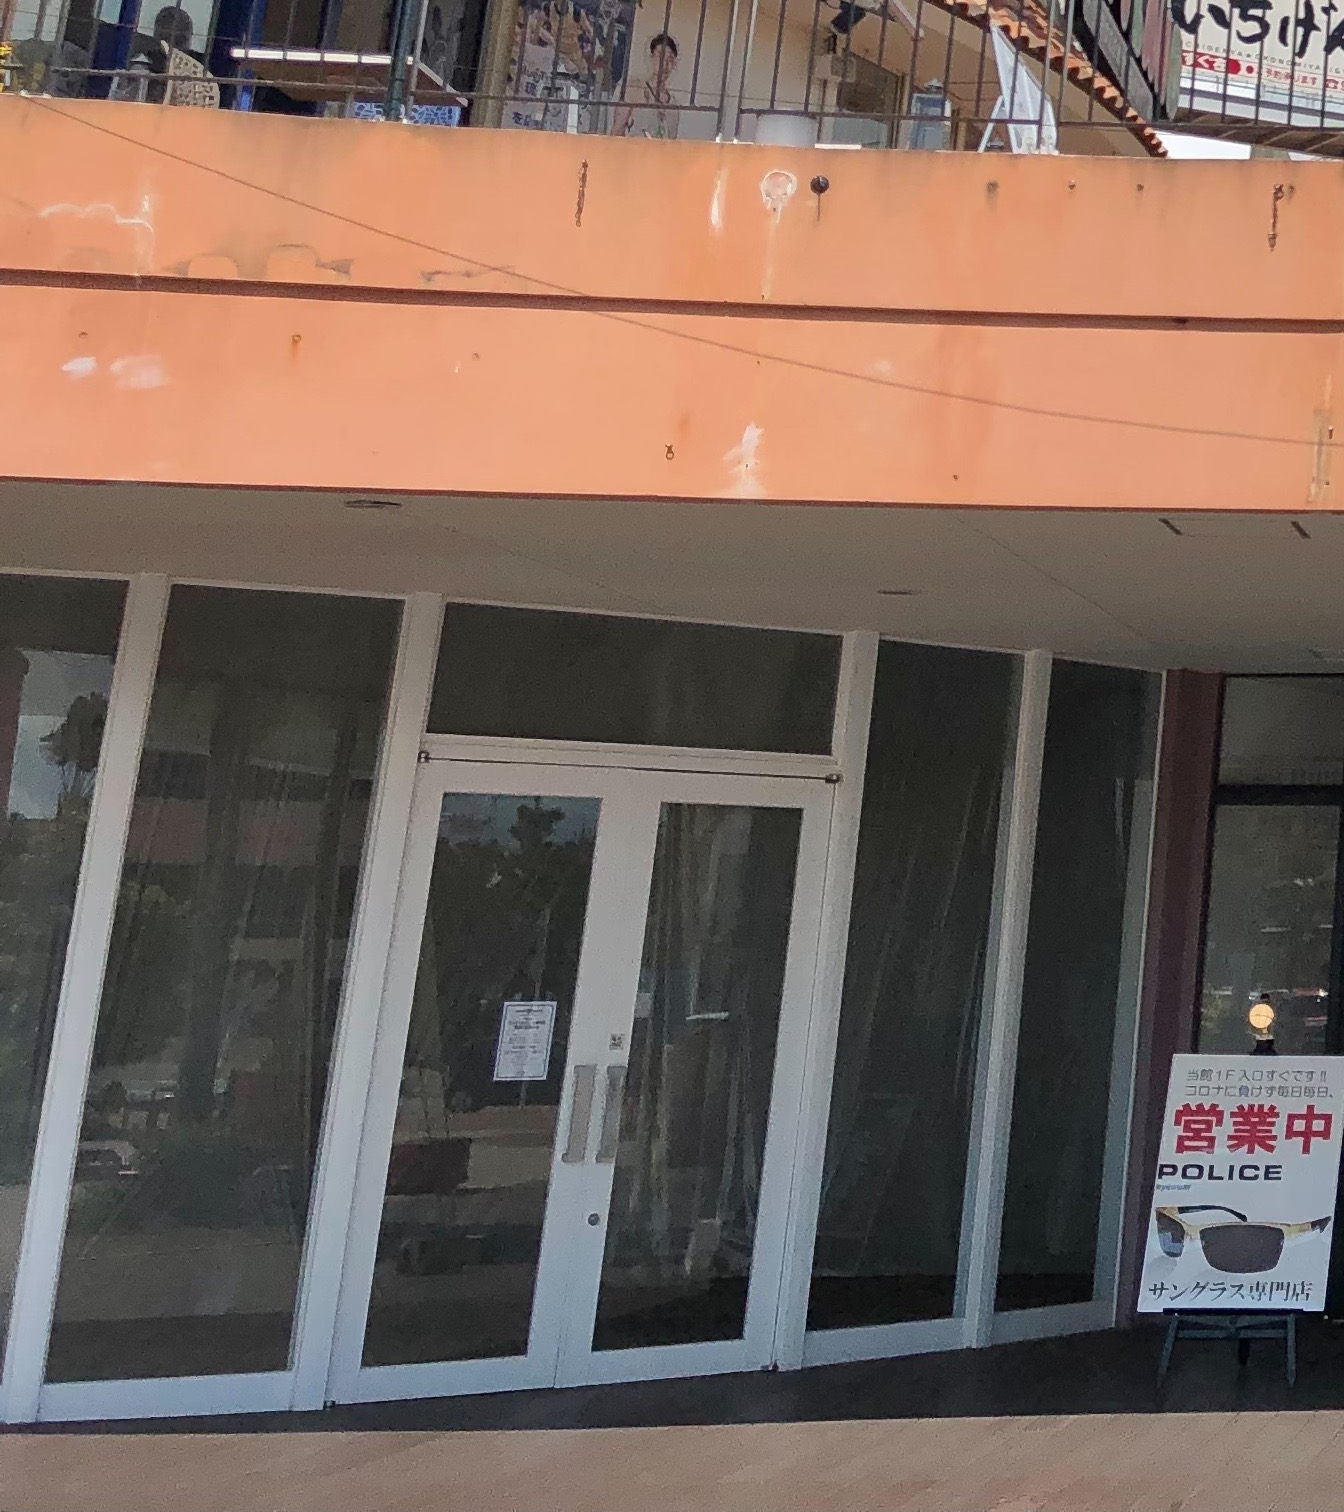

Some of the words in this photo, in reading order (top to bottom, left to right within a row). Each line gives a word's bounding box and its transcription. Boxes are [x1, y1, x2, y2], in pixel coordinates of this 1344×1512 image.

[1173, 1102, 1333, 1155] 営業中
[1157, 1163, 1283, 1182] POLICE
[1148, 1280, 1314, 1302] サングラス専門店
